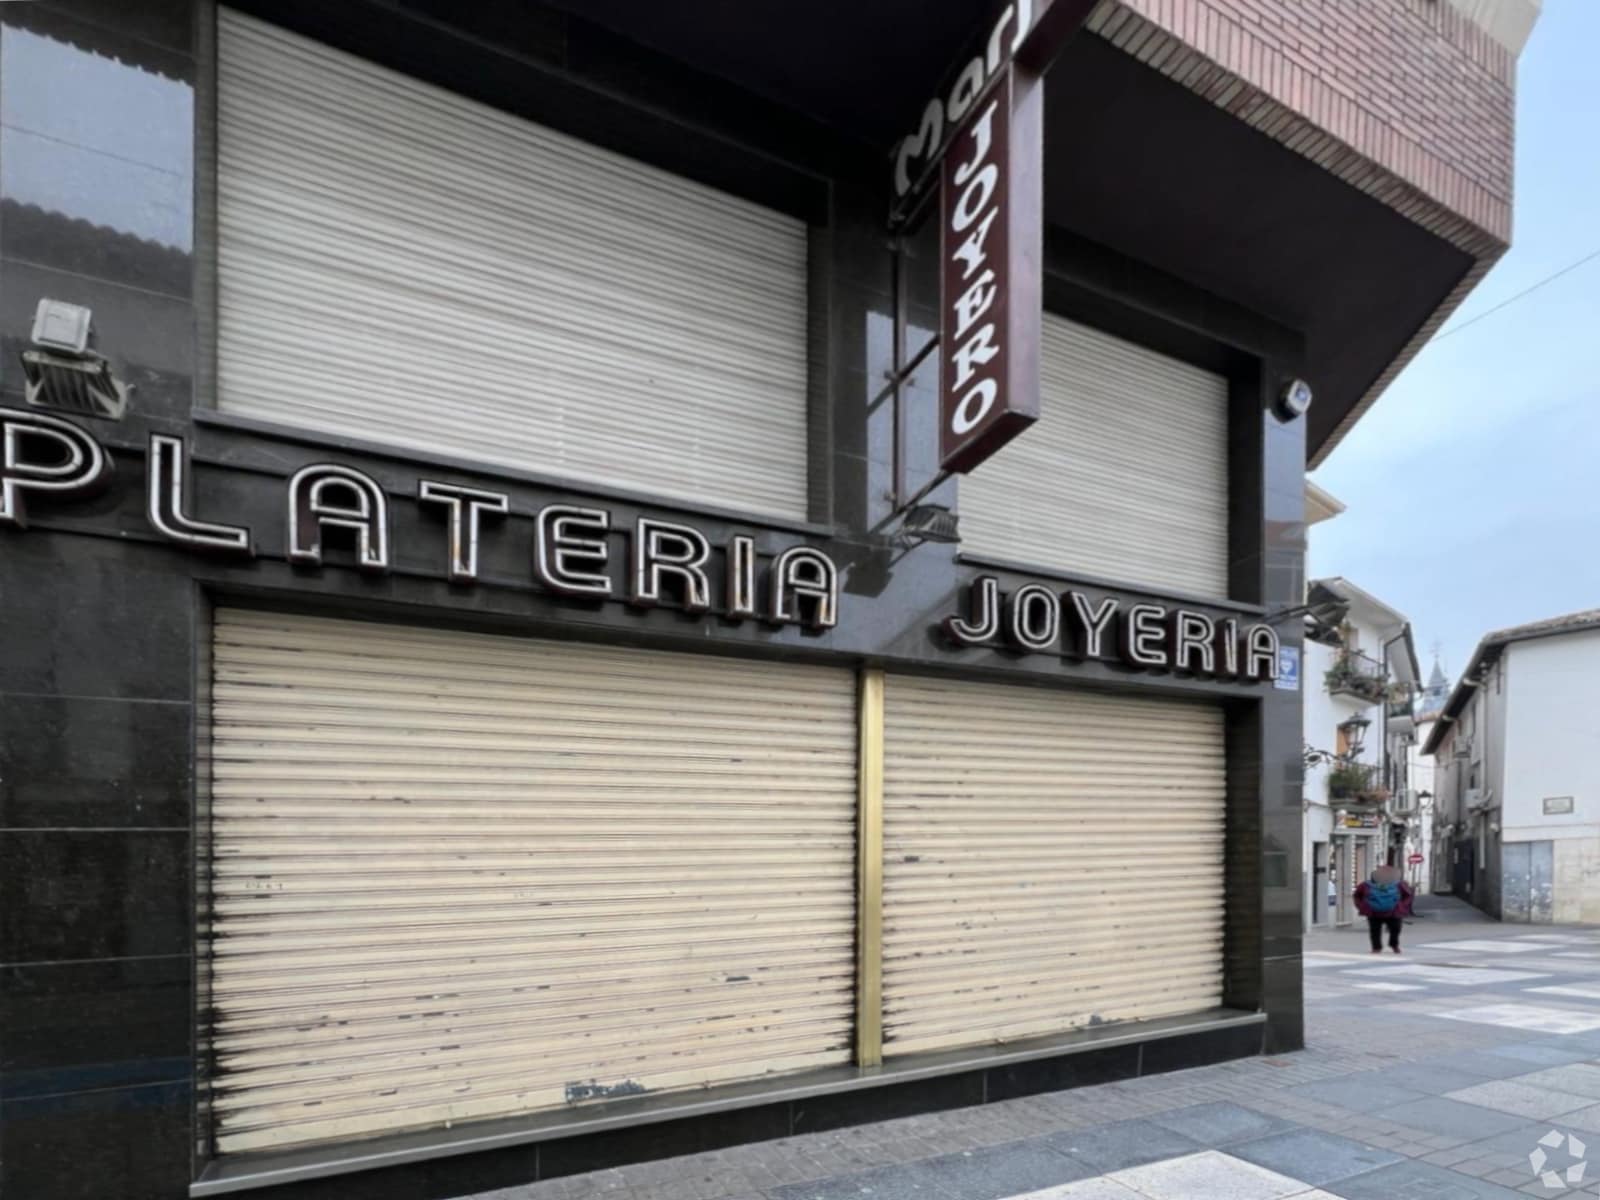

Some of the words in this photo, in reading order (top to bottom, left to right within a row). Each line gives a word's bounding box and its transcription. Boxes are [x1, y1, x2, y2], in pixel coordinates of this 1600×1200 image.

[952, 100, 999, 435] JOYERO
[0, 407, 839, 628] PLATERIA
[950, 577, 1281, 679] JOYERIA
